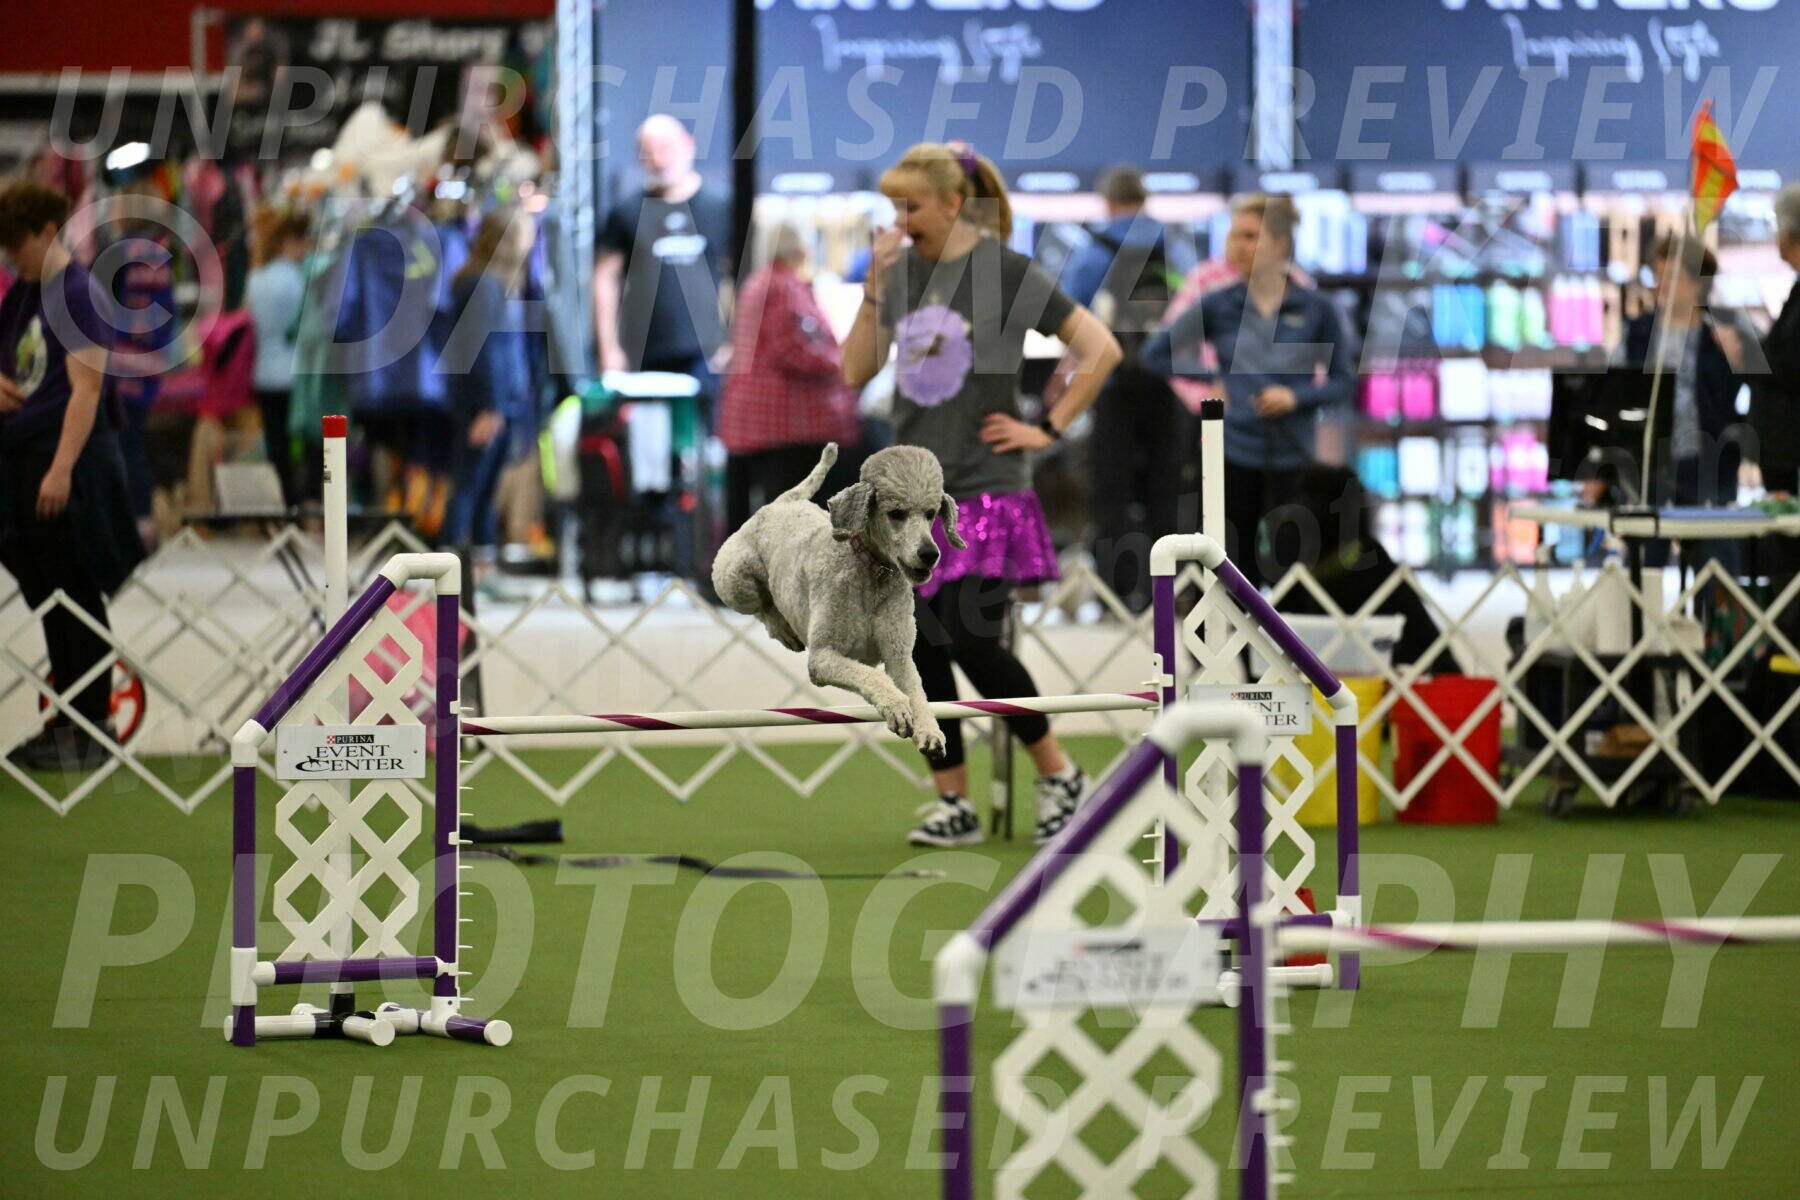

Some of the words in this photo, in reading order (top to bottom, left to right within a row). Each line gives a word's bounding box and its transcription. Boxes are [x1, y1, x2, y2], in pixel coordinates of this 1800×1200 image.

[1239, 692, 1272, 700] PURINA
[1265, 714, 1298, 726] TER
[336, 735, 374, 744] PURINA
[315, 744, 390, 758] EVENT
[295, 757, 404, 772] CENTER
